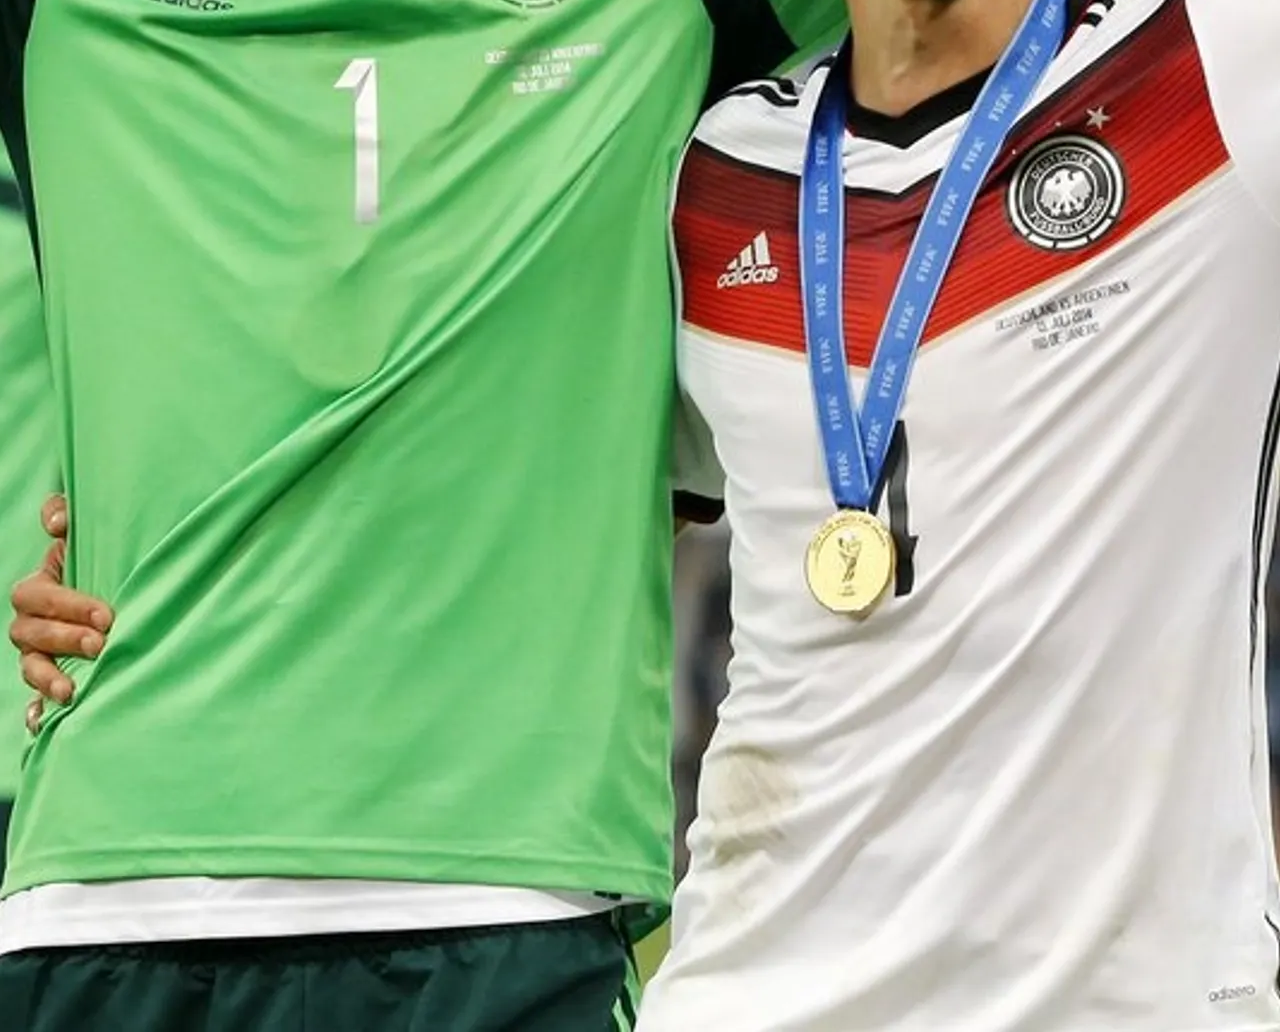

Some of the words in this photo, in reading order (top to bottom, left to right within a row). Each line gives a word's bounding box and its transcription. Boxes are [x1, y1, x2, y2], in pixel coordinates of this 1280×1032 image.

[1017, 42, 1041, 74] FIFA
[989, 88, 1014, 121] FIFA
[333, 58, 378, 226] 1
[816, 135, 828, 166] FIFA
[962, 137, 986, 171] FIFA
[1031, 150, 1094, 180] DEUTSCHER
[817, 182, 829, 214] FIFA
[936, 190, 959, 226] FIFA
[815, 232, 827, 266] FIFA
[916, 245, 937, 282] FIFA
[716, 264, 779, 290] adidas
[817, 283, 828, 316] FIFA
[895, 301, 915, 340] FIFA
[822, 338, 834, 373] FIFA
[879, 359, 897, 398] FIFA
[826, 395, 840, 431] FIFA
[836, 451, 850, 486] FIFA
